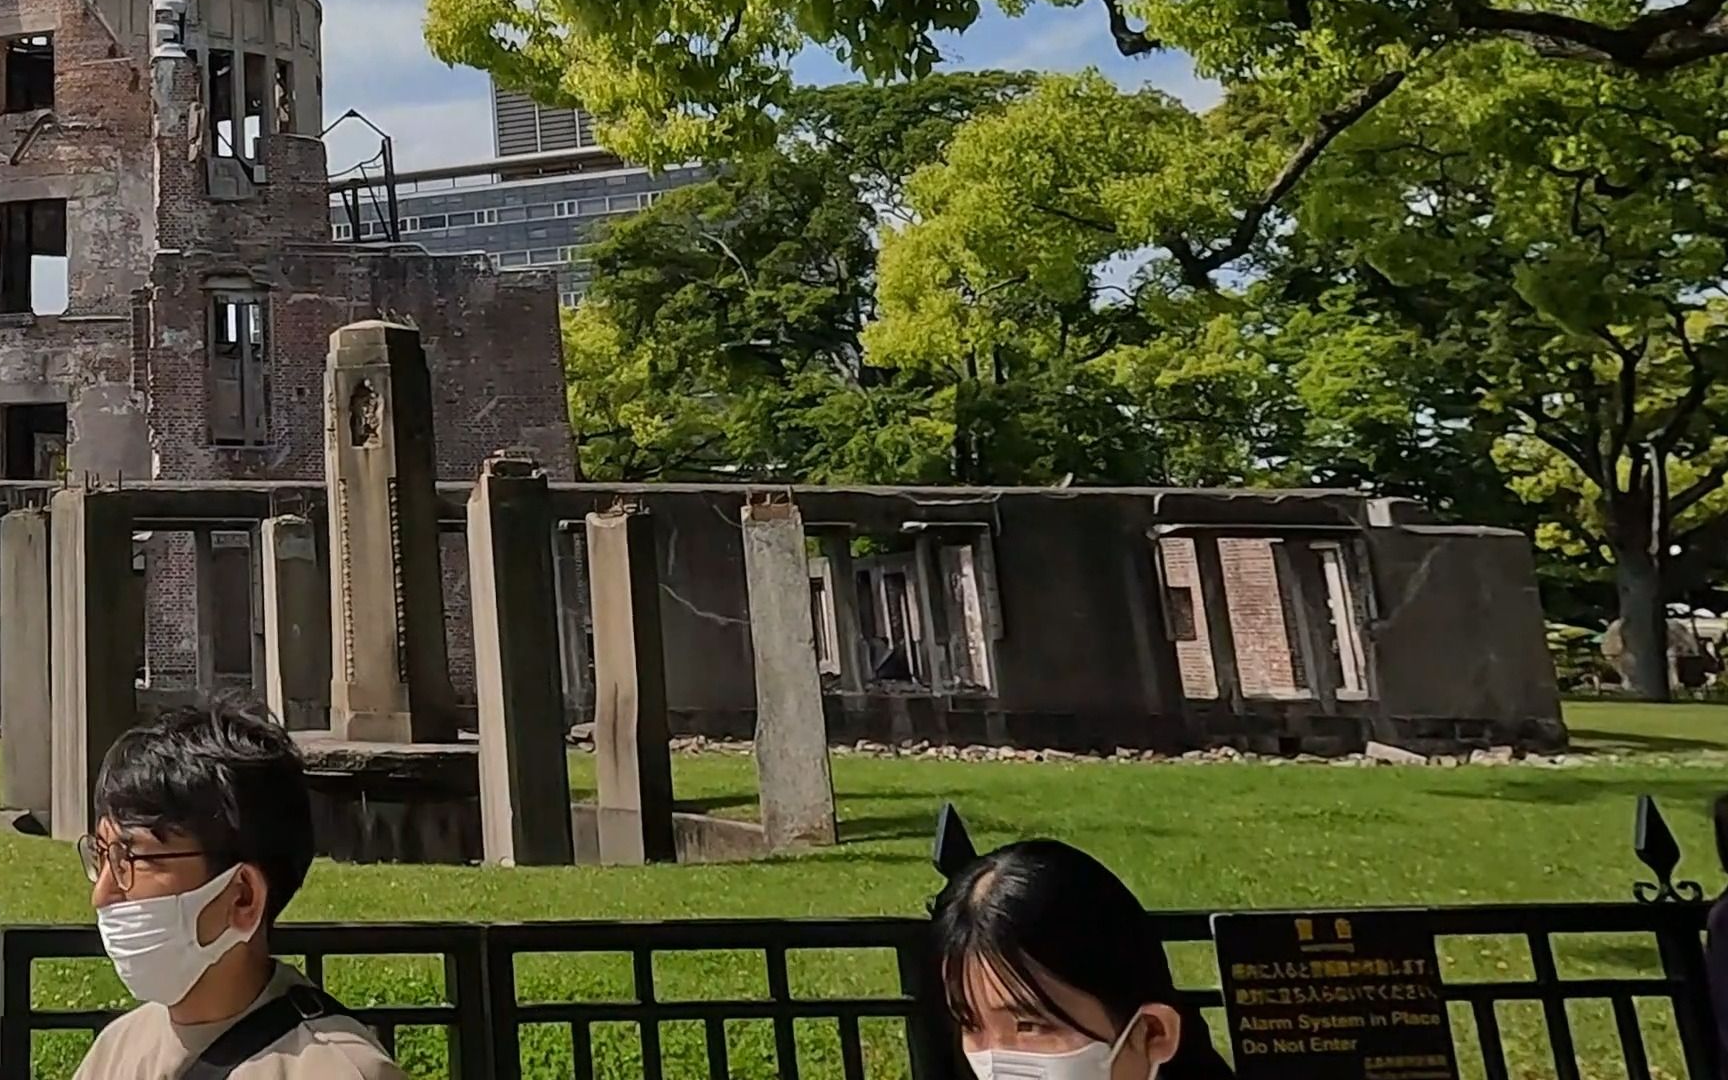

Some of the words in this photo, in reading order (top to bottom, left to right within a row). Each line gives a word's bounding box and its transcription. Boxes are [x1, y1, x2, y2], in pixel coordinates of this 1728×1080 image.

[1239, 1016, 1293, 1031] Alarm
[1298, 1014, 1365, 1033] System
[1391, 1011, 1441, 1026] Place
[1242, 1039, 1267, 1055] Do
[1273, 1039, 1306, 1054] Not
[1309, 1036, 1358, 1052] Enter
